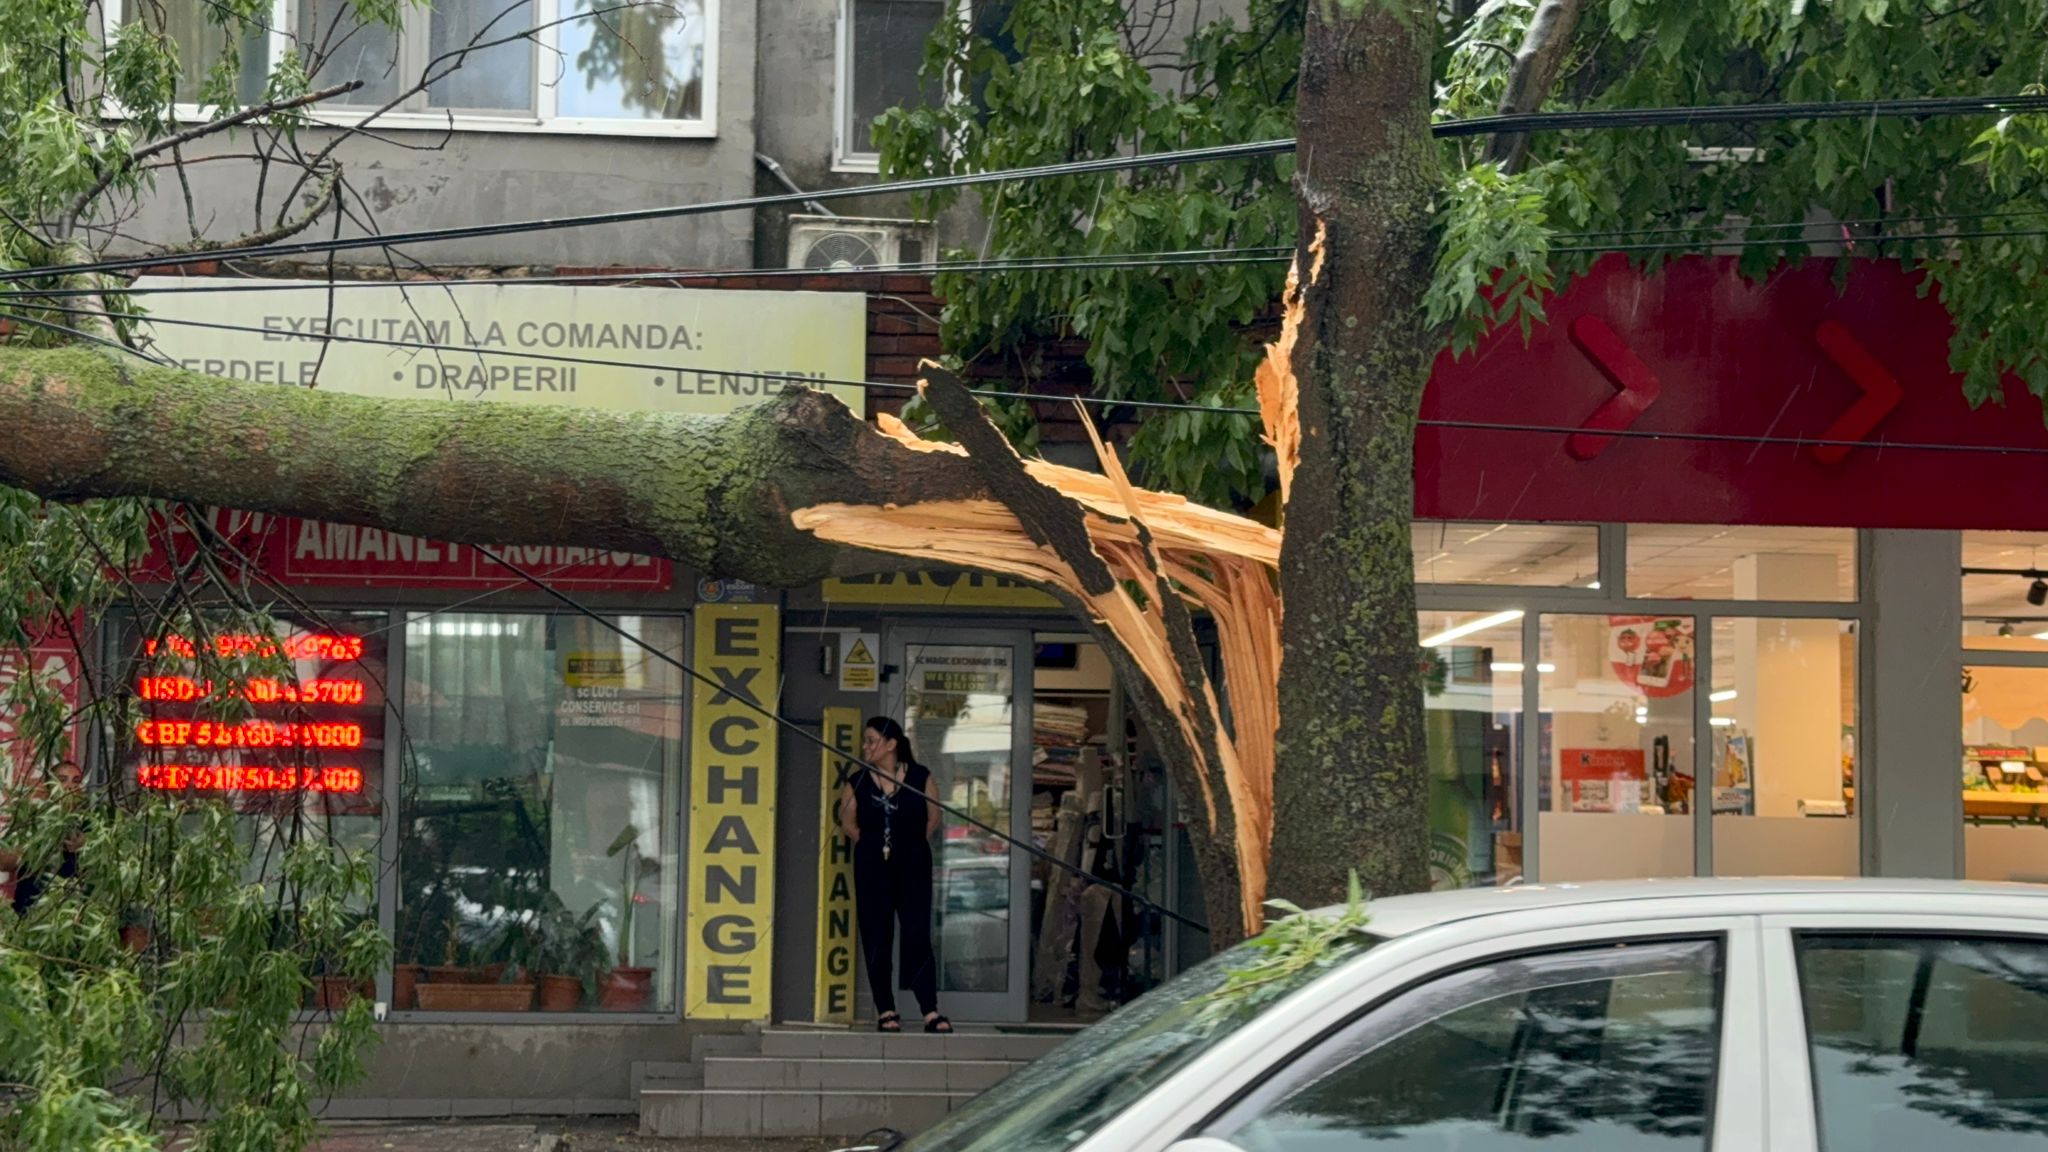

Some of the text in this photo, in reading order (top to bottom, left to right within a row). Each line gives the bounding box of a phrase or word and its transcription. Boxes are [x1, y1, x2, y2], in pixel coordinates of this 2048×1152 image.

[262, 315, 703, 351] EXECUTAM LA COMANDA:
[158, 357, 319, 387] ERDELE
[415, 363, 577, 392] DRAPERII
[592, 685, 619, 698] LUCY
[560, 700, 625, 714] CONSERVICE
[702, 617, 763, 1006] EXCHANGE
